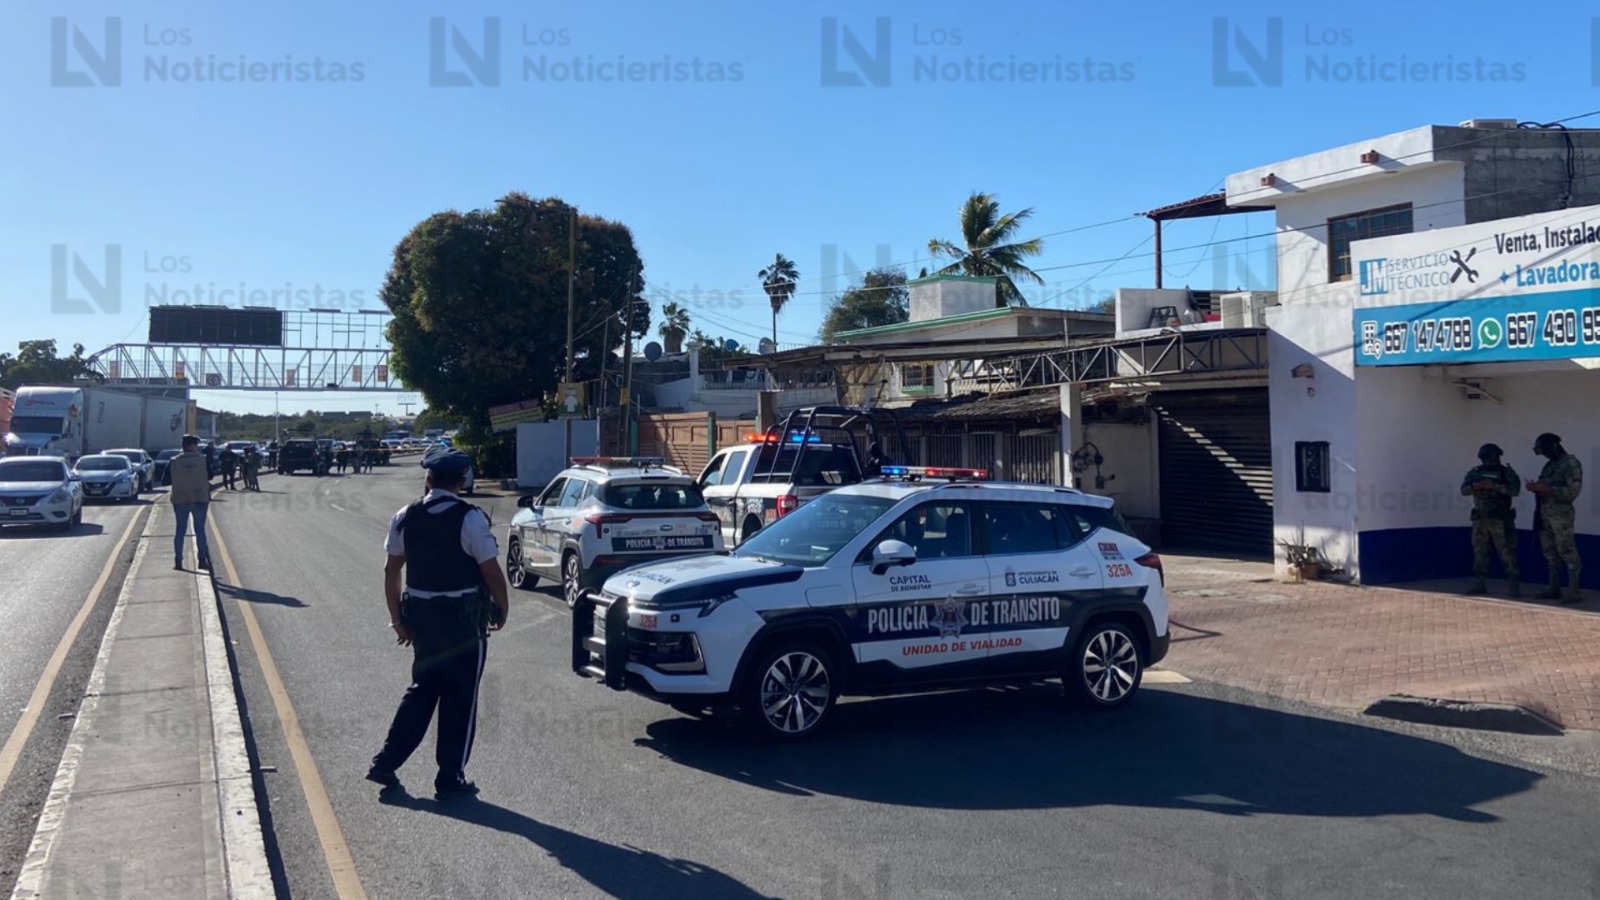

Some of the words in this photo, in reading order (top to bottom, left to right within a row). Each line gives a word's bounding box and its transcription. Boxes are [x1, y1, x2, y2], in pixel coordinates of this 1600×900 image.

[1494, 231, 1541, 255] Venta,
[1388, 252, 1448, 272] SERVICIO
[1383, 321, 1408, 354] 667
[1412, 316, 1472, 353] 1474788
[1506, 312, 1537, 349] 667
[1543, 308, 1577, 347] 430
[667, 536, 677, 547] DE
[889, 575, 931, 585] CAPITAL
[1106, 563, 1133, 578] 325A
[868, 600, 929, 634] POLICÍA
[971, 601, 989, 626] DE
[991, 594, 1060, 624] TRÁNSITO
[902, 643, 948, 656] UNIDAD
[951, 641, 966, 651] DE
[970, 637, 1023, 650] VIALIDAD
